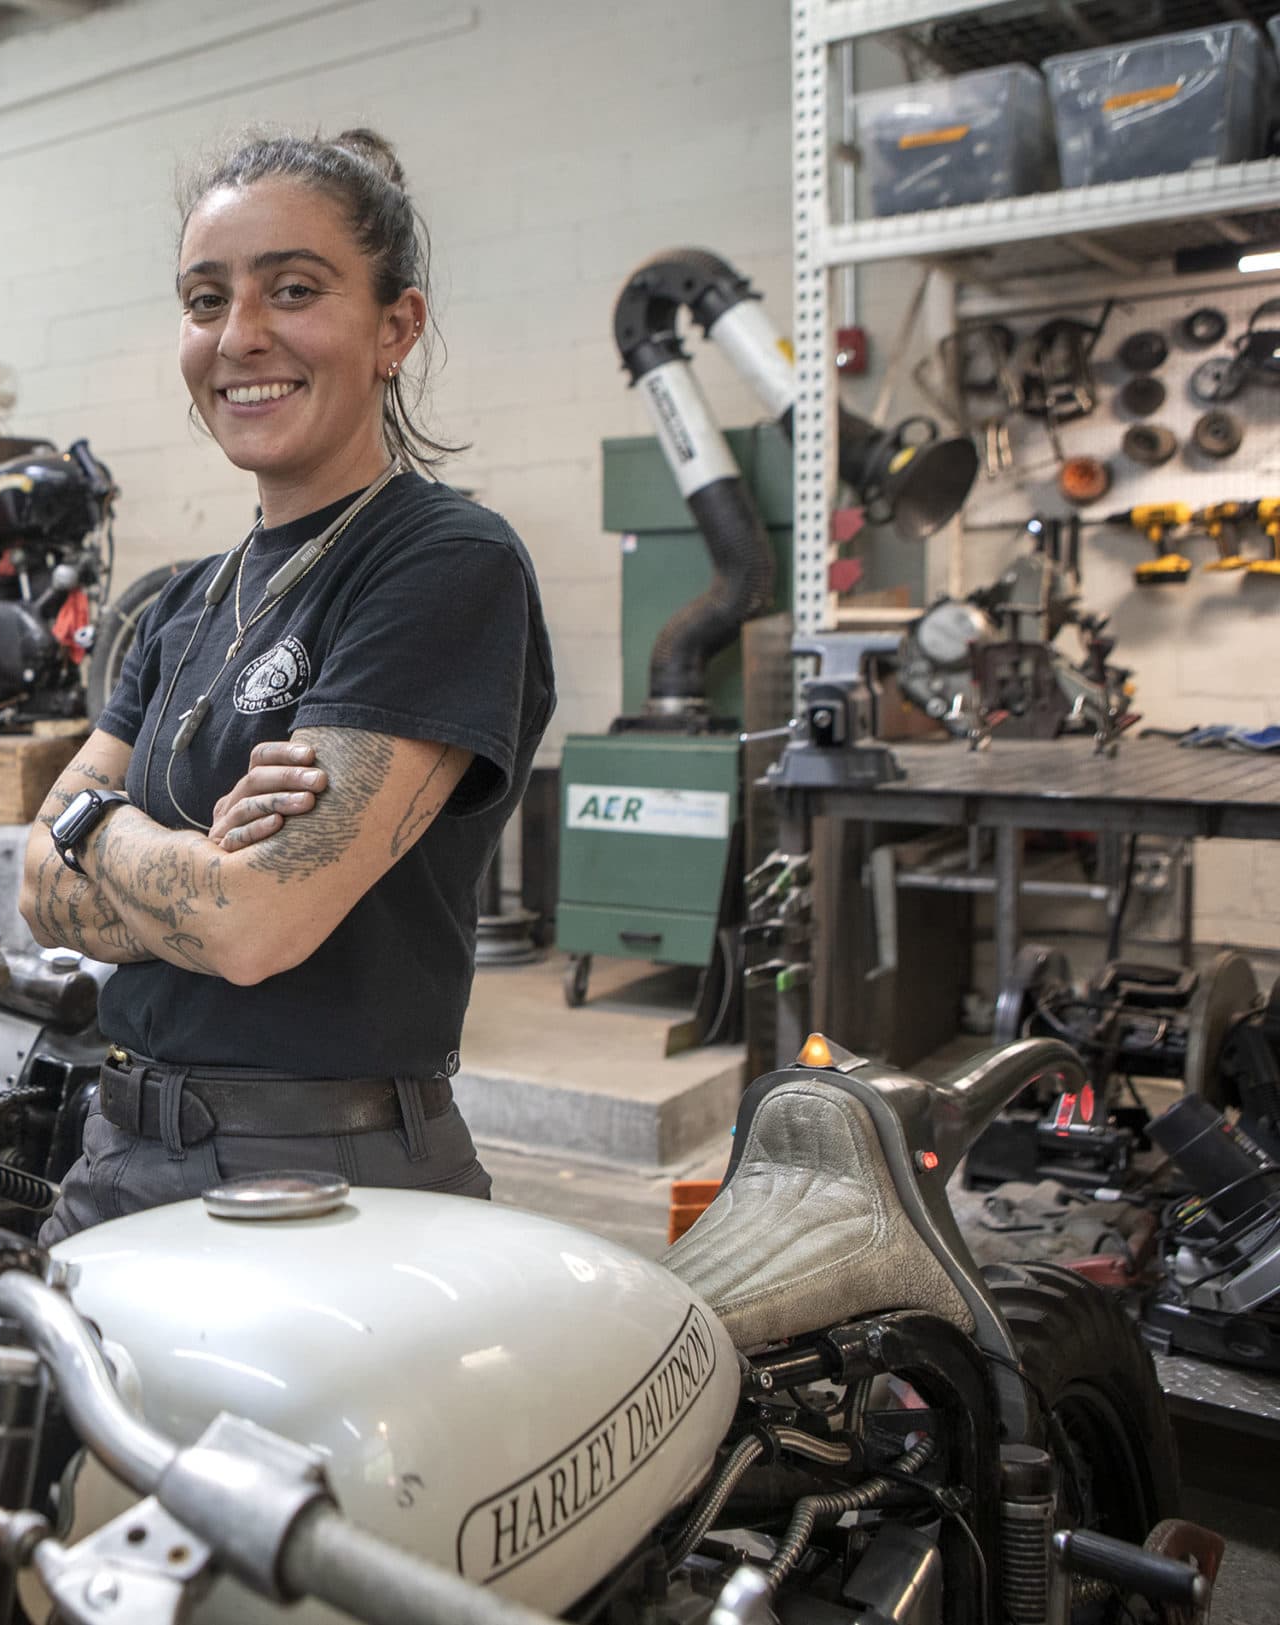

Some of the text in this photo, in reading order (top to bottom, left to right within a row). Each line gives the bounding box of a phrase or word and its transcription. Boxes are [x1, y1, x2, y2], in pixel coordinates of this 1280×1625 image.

[271, 692, 294, 706] MA
[577, 795, 644, 823] AER
[491, 1316, 710, 1568] HARLEY DAVIDSON
